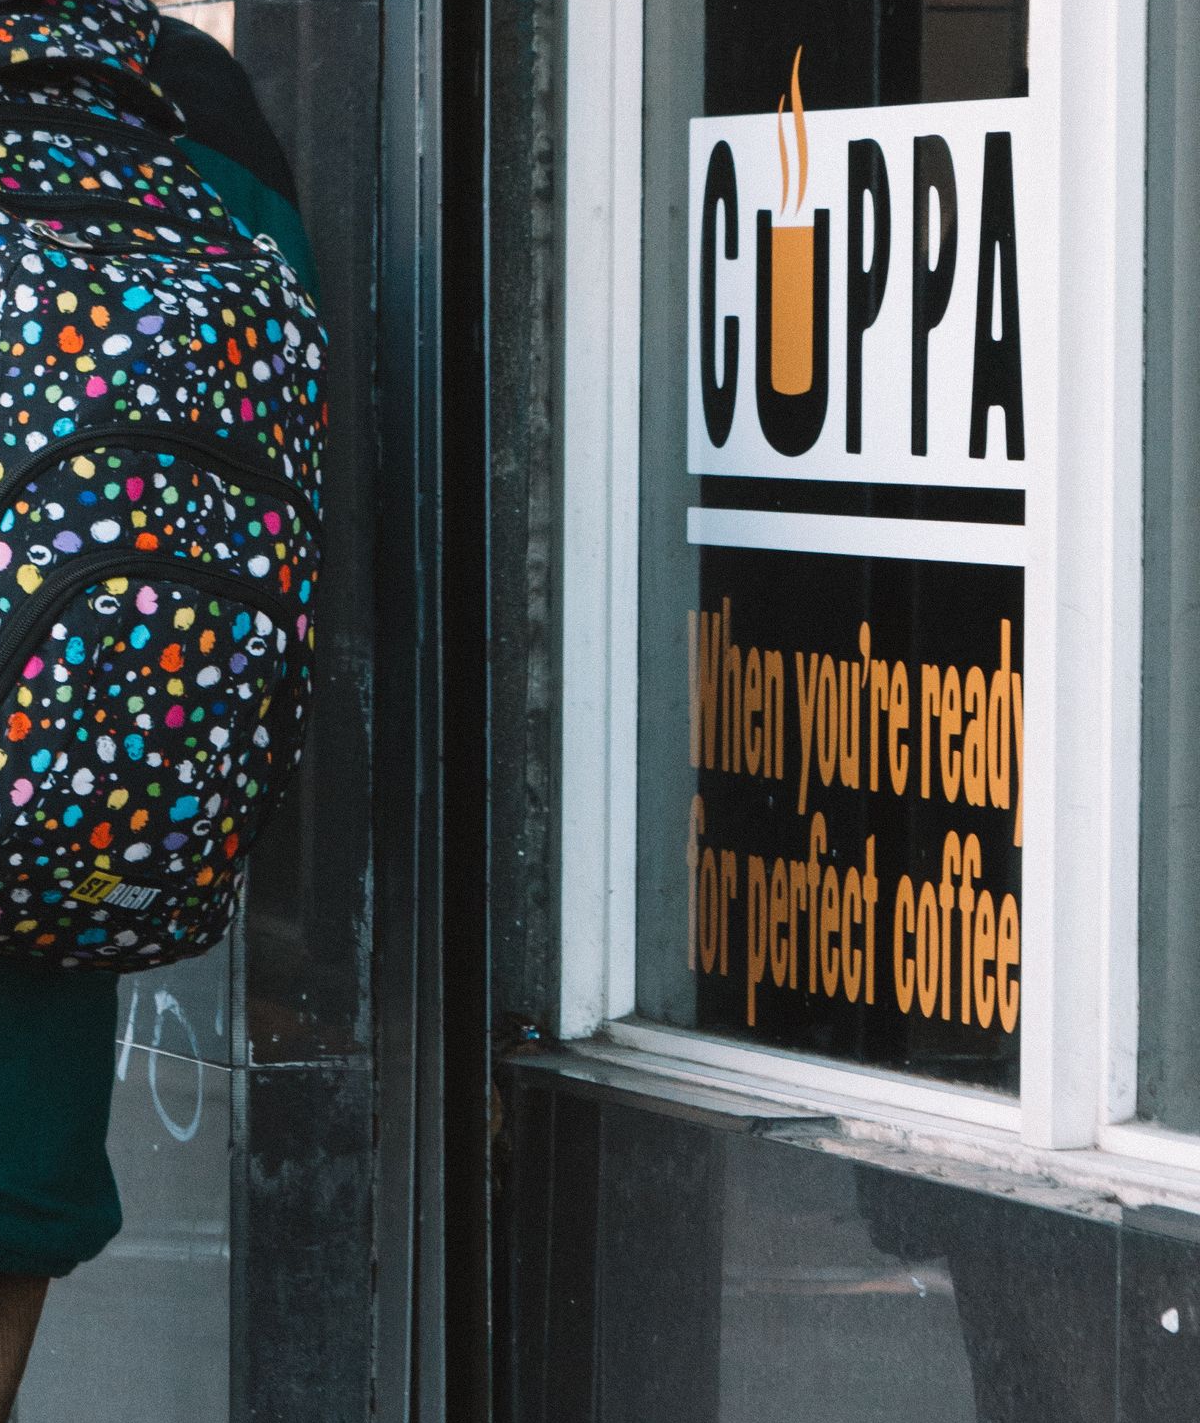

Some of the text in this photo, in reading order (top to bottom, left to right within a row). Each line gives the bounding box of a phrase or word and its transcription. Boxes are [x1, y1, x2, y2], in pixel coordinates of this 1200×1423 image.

[701, 131, 1025, 461] CUPPA
[688, 596, 1024, 847] When you're ready
[102, 882, 162, 910] RIGHT
[687, 794, 1020, 1034] for perfect coffee
